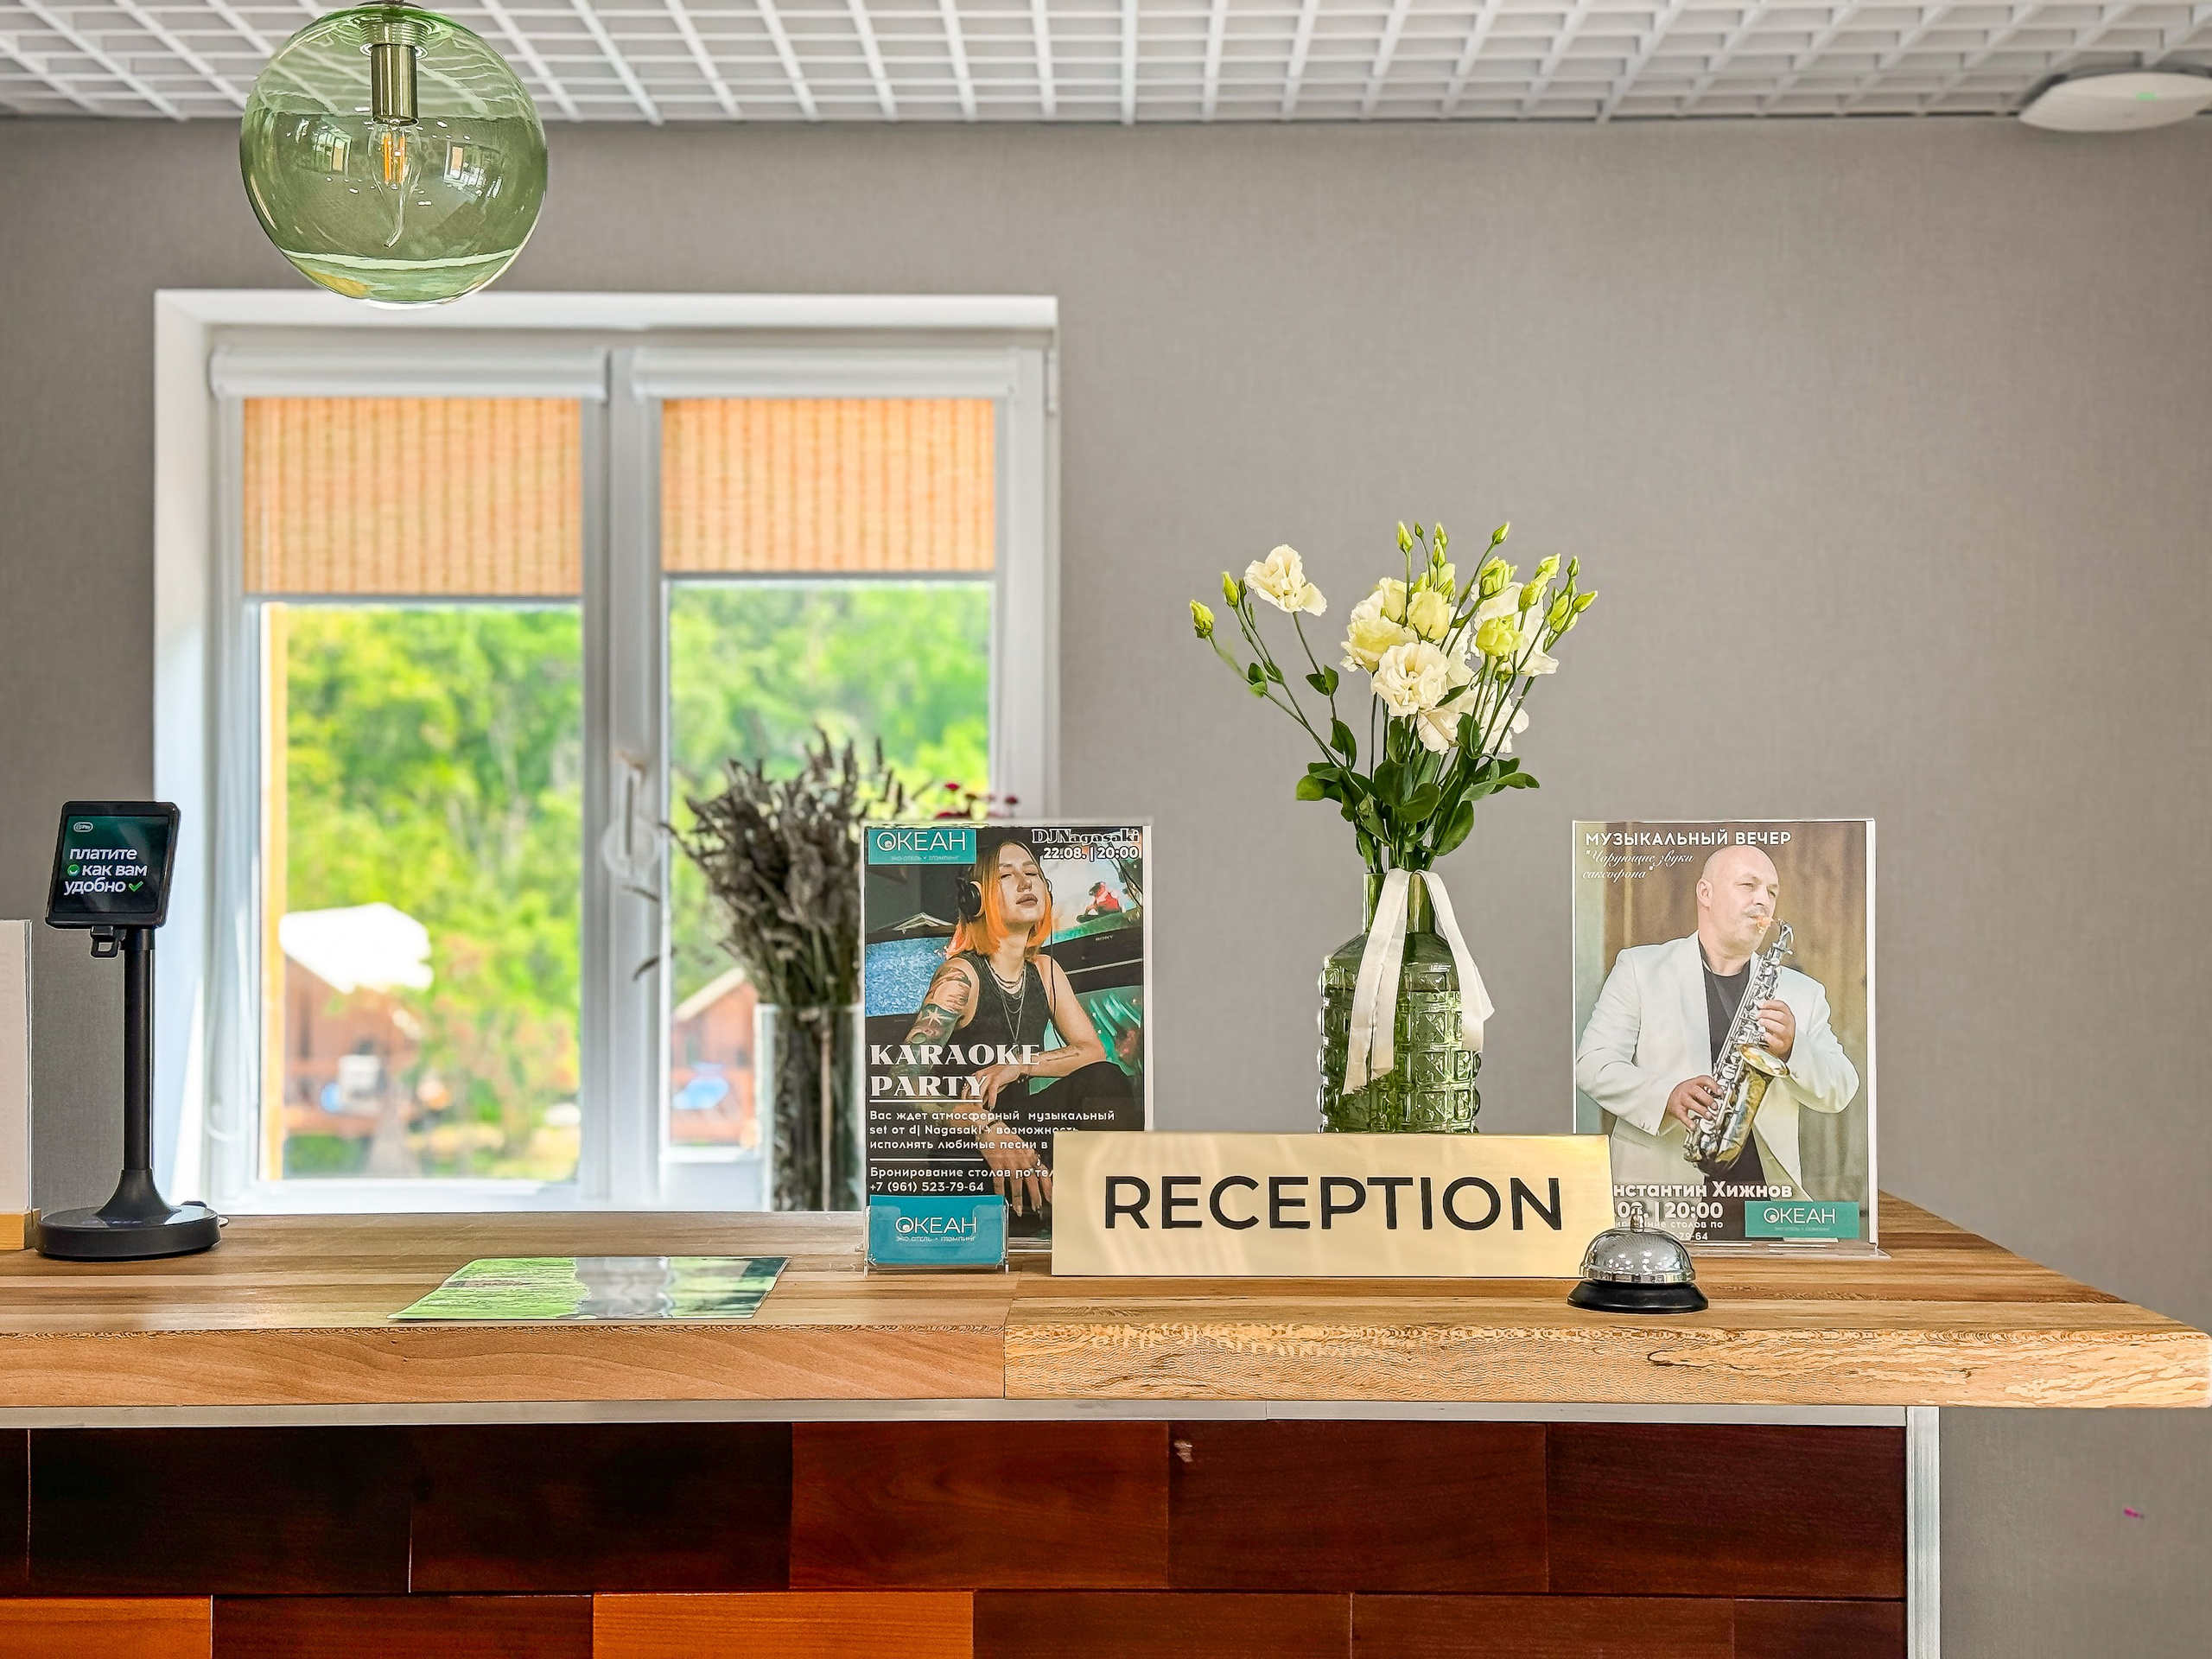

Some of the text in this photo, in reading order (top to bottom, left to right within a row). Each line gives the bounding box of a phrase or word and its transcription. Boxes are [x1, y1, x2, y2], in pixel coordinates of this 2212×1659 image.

[876, 831, 966, 851] ОКЕАН
[1586, 829, 1791, 845] МУЗЫКАЛЬНЫЙ ВЕЧЕР
[70, 849, 137, 860] платите
[1043, 847, 1087, 859] 22.08.
[1096, 847, 1139, 859] 20:00
[82, 865, 148, 876] как вам
[64, 877, 126, 895] удобно
[870, 1044, 1040, 1065] KARAOKE
[870, 1076, 988, 1096] PARTY
[870, 1110, 1115, 1122] Вас ждет атмосферный музыкальный
[869, 1125, 887, 1135] set
[925, 1125, 982, 1136] Nagasaki
[870, 1141, 933, 1149] исполнять
[938, 1140, 995, 1149] любимые
[870, 1166, 963, 1179] Бронирование
[968, 1168, 1011, 1178] столов
[1015, 1169, 1033, 1179] по
[870, 1181, 984, 1192] +7 (961) 523-79-64
[1613, 1180, 1793, 1198] нстантин Хижнов
[1105, 1175, 1562, 1230] RECEPTION
[1664, 1201, 1723, 1218] 20:00
[1764, 1207, 1835, 1224] ОКЕАН
[895, 1217, 976, 1233] ОКЕАН
